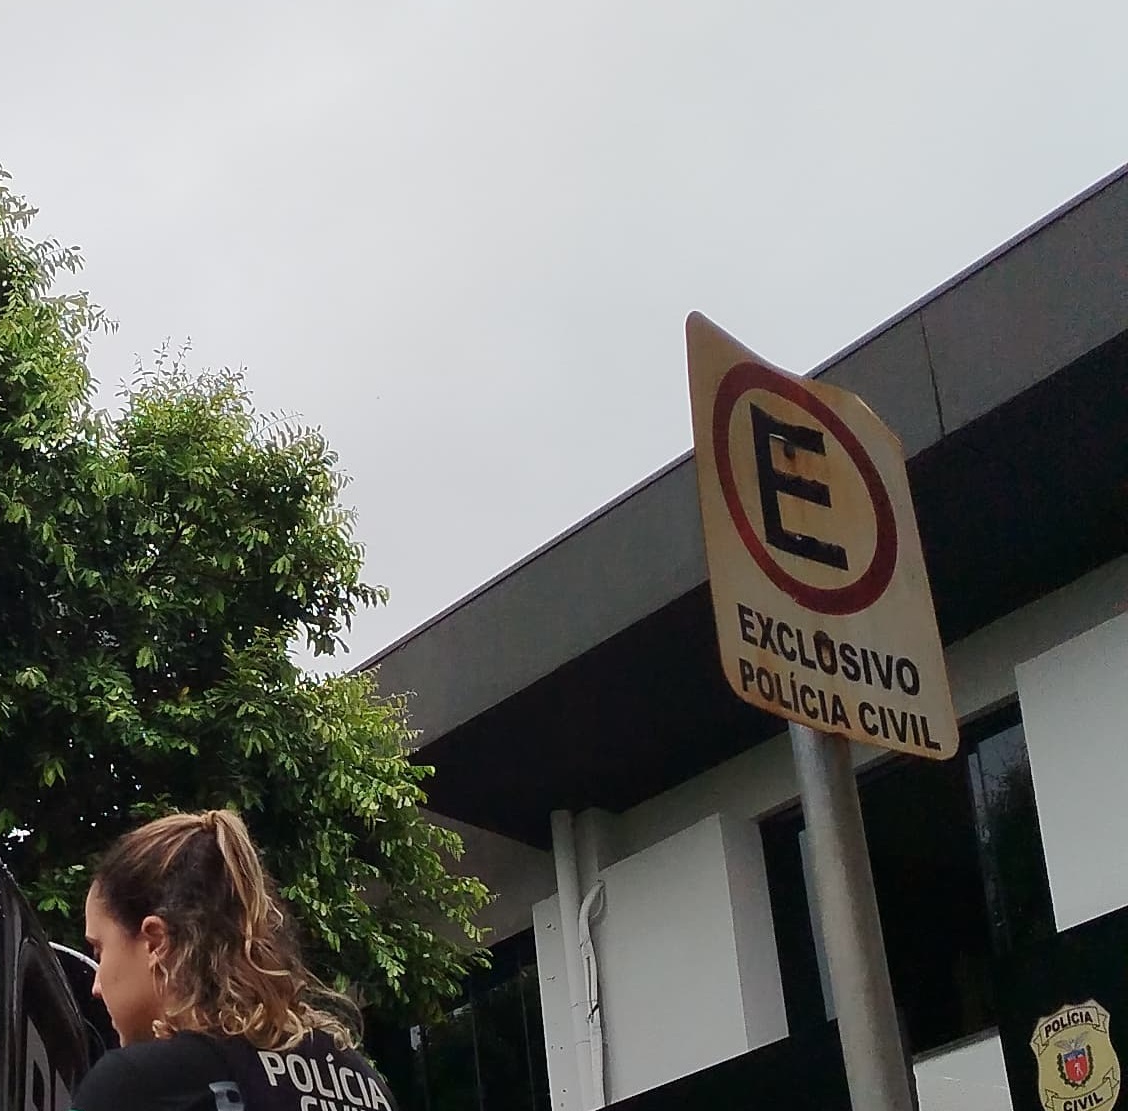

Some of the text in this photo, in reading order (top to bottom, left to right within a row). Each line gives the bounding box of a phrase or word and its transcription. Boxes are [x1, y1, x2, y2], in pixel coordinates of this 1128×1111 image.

[749, 402, 849, 571] E
[736, 602, 920, 696] EXCLUSIVO
[738, 656, 942, 752] POLÍCIA CIVIL
[1043, 1010, 1094, 1038] POLÍCIA
